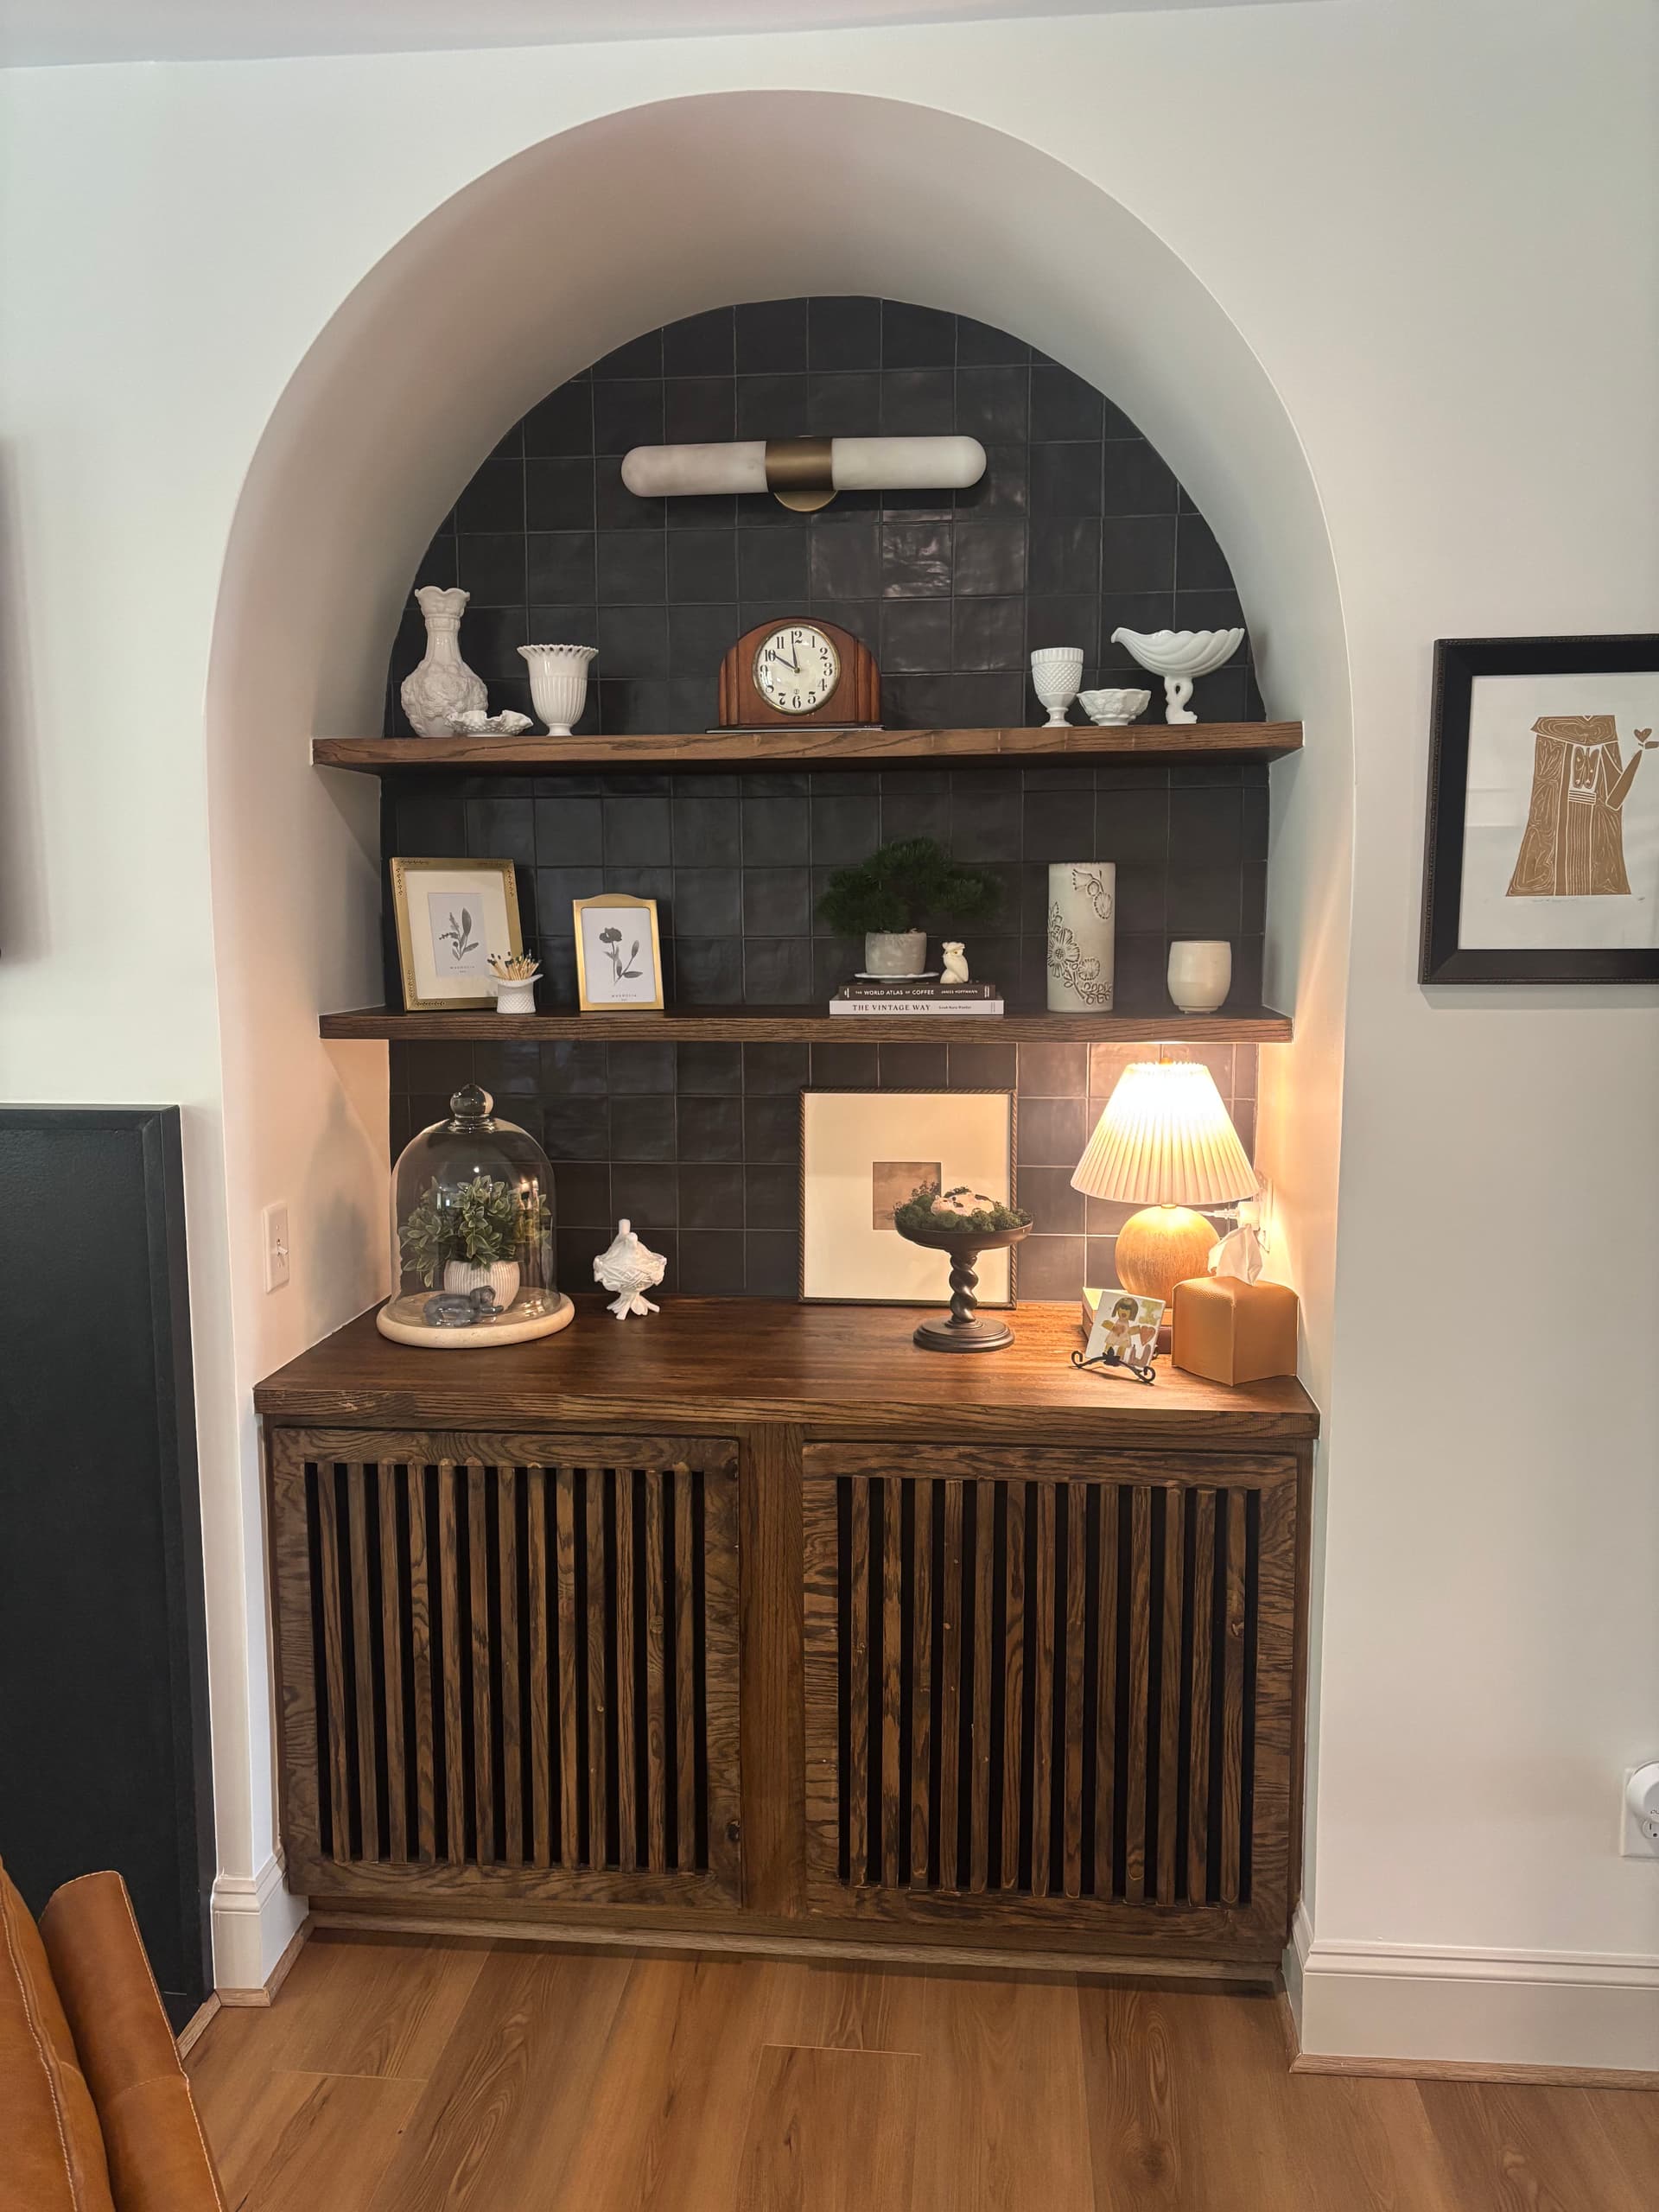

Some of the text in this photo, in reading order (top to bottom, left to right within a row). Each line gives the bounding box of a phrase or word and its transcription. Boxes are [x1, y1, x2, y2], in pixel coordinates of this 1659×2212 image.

[777, 636, 785, 649] 11
[791, 631, 803, 644] 12
[812, 635, 816, 648] 1
[765, 649, 776, 662] 10
[820, 647, 829, 660] 2
[823, 662, 833, 677] 3
[817, 678, 828, 691] 4
[779, 692, 786, 705] 7
[792, 695, 801, 709] 6
[807, 691, 817, 704] 5
